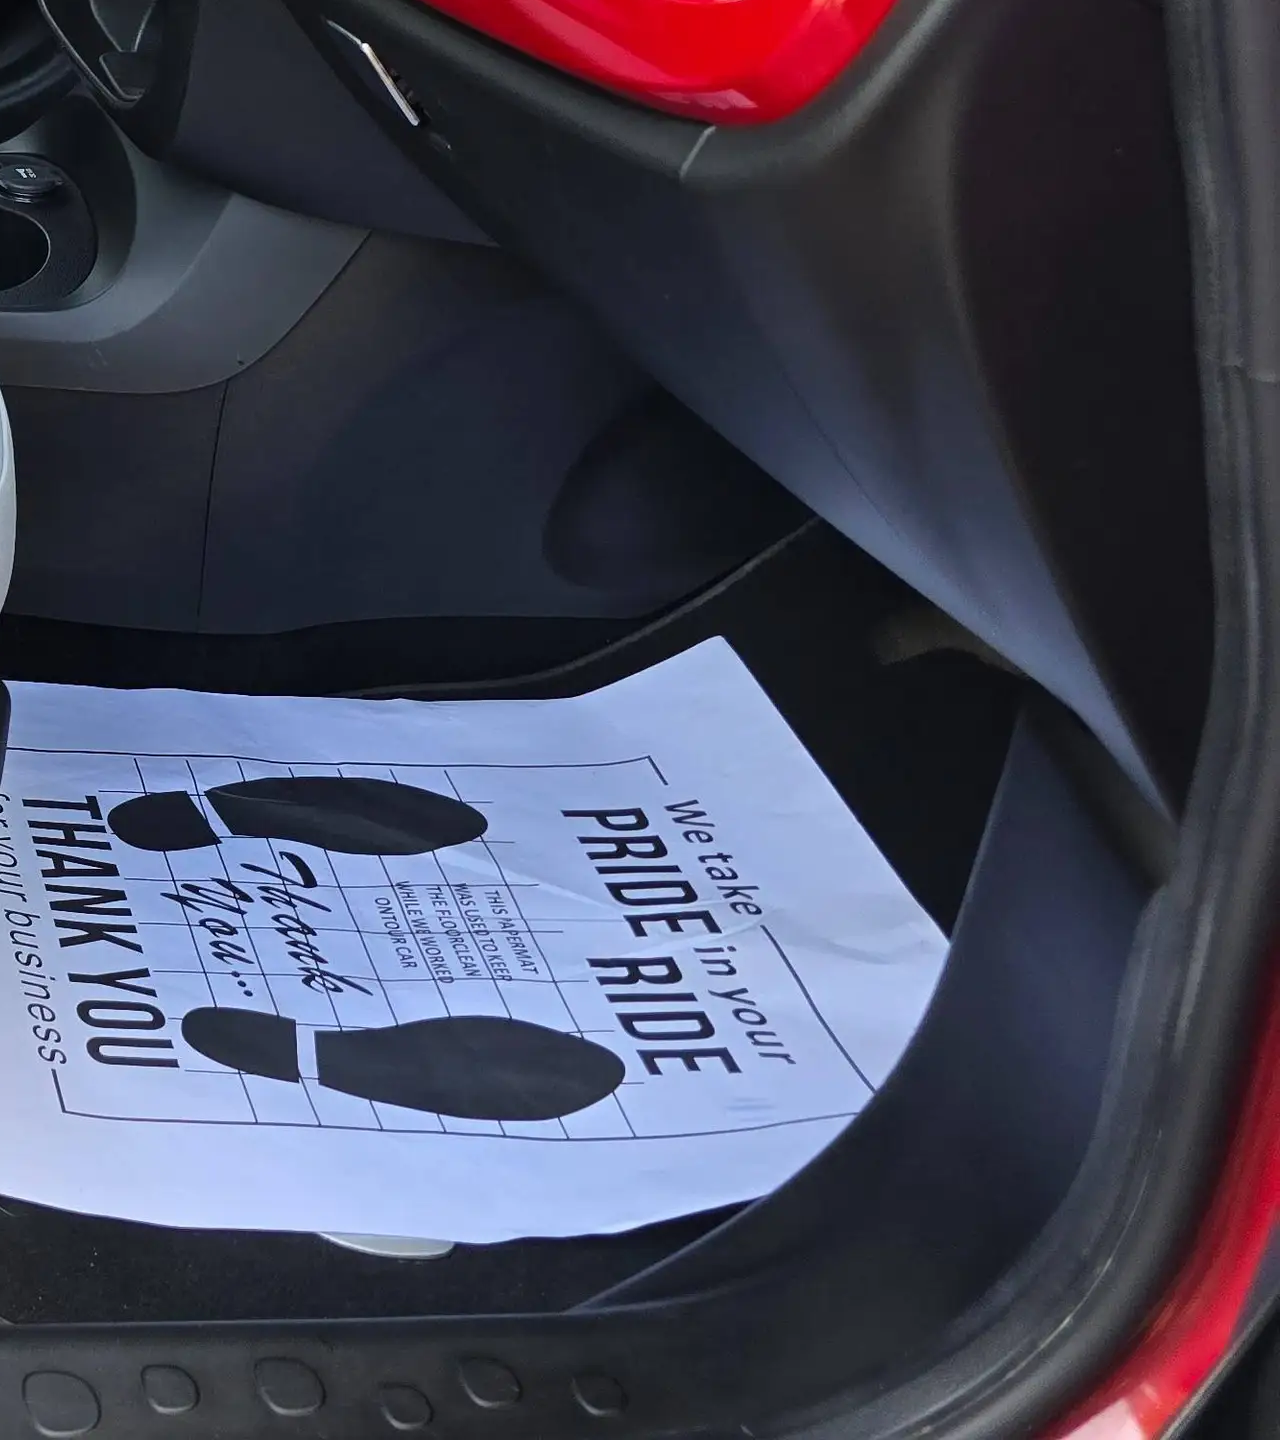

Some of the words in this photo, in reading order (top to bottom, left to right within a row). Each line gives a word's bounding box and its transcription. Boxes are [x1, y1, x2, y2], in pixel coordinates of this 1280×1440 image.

[22, 794, 144, 954] THANK
[426, 886, 448, 907] THE
[454, 882, 476, 908] WAS
[484, 890, 508, 915] THIS
[560, 807, 723, 938] PRIDE
[664, 799, 715, 844] We
[698, 852, 762, 916] take
[239, 850, 374, 997] Thank
[395, 880, 423, 916] WHILE
[420, 936, 455, 984] WORKED
[395, 946, 418, 969] CAR
[464, 910, 491, 937] USED
[478, 937, 499, 953] TO
[693, 946, 737, 976] in
[3, 908, 68, 1066] business
[67, 967, 180, 1069] YOU
[586, 956, 743, 1076] RIDE
[708, 987, 797, 1065] your
